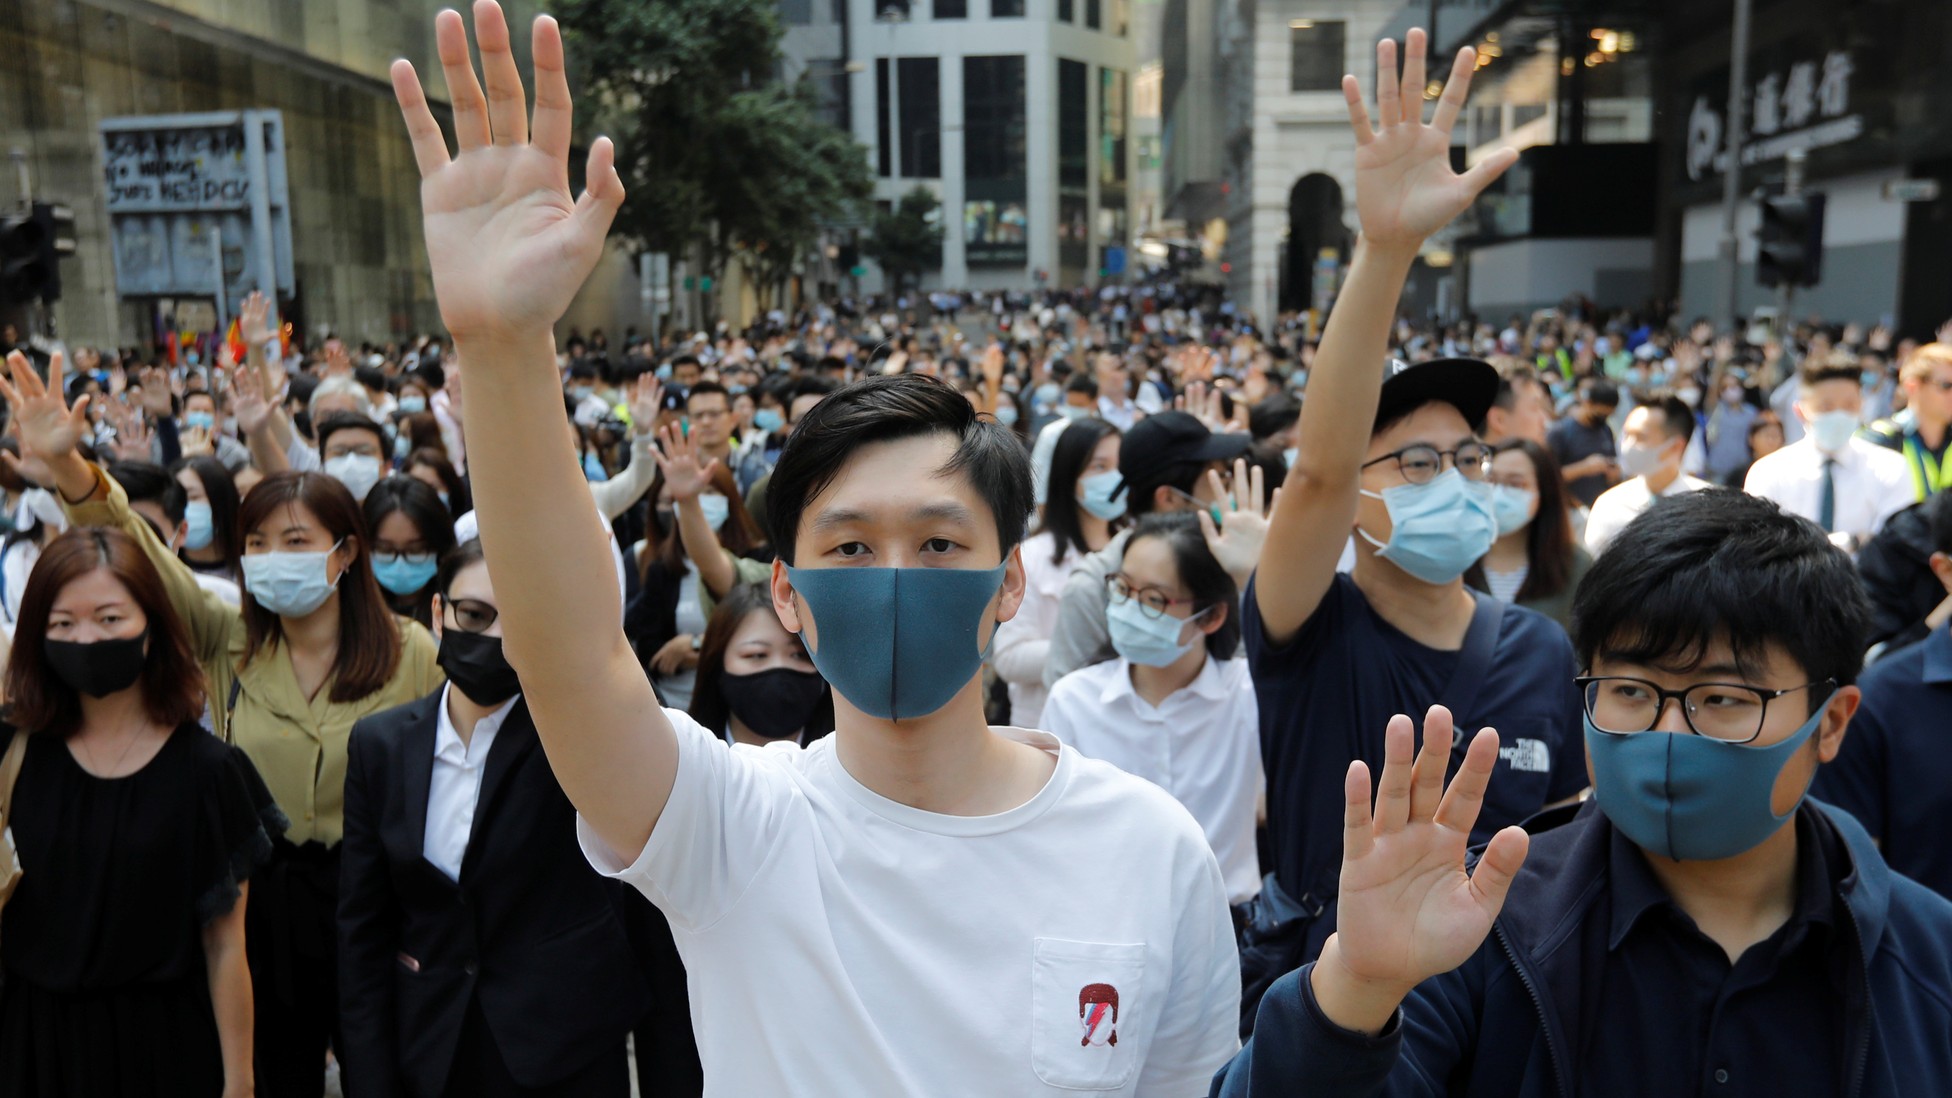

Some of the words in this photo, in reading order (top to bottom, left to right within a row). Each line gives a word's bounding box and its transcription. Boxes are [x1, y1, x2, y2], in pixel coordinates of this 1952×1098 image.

[1516, 738, 1532, 749] THE
[1500, 747, 1532, 760] NORTH
[1511, 759, 1532, 771] FACE
